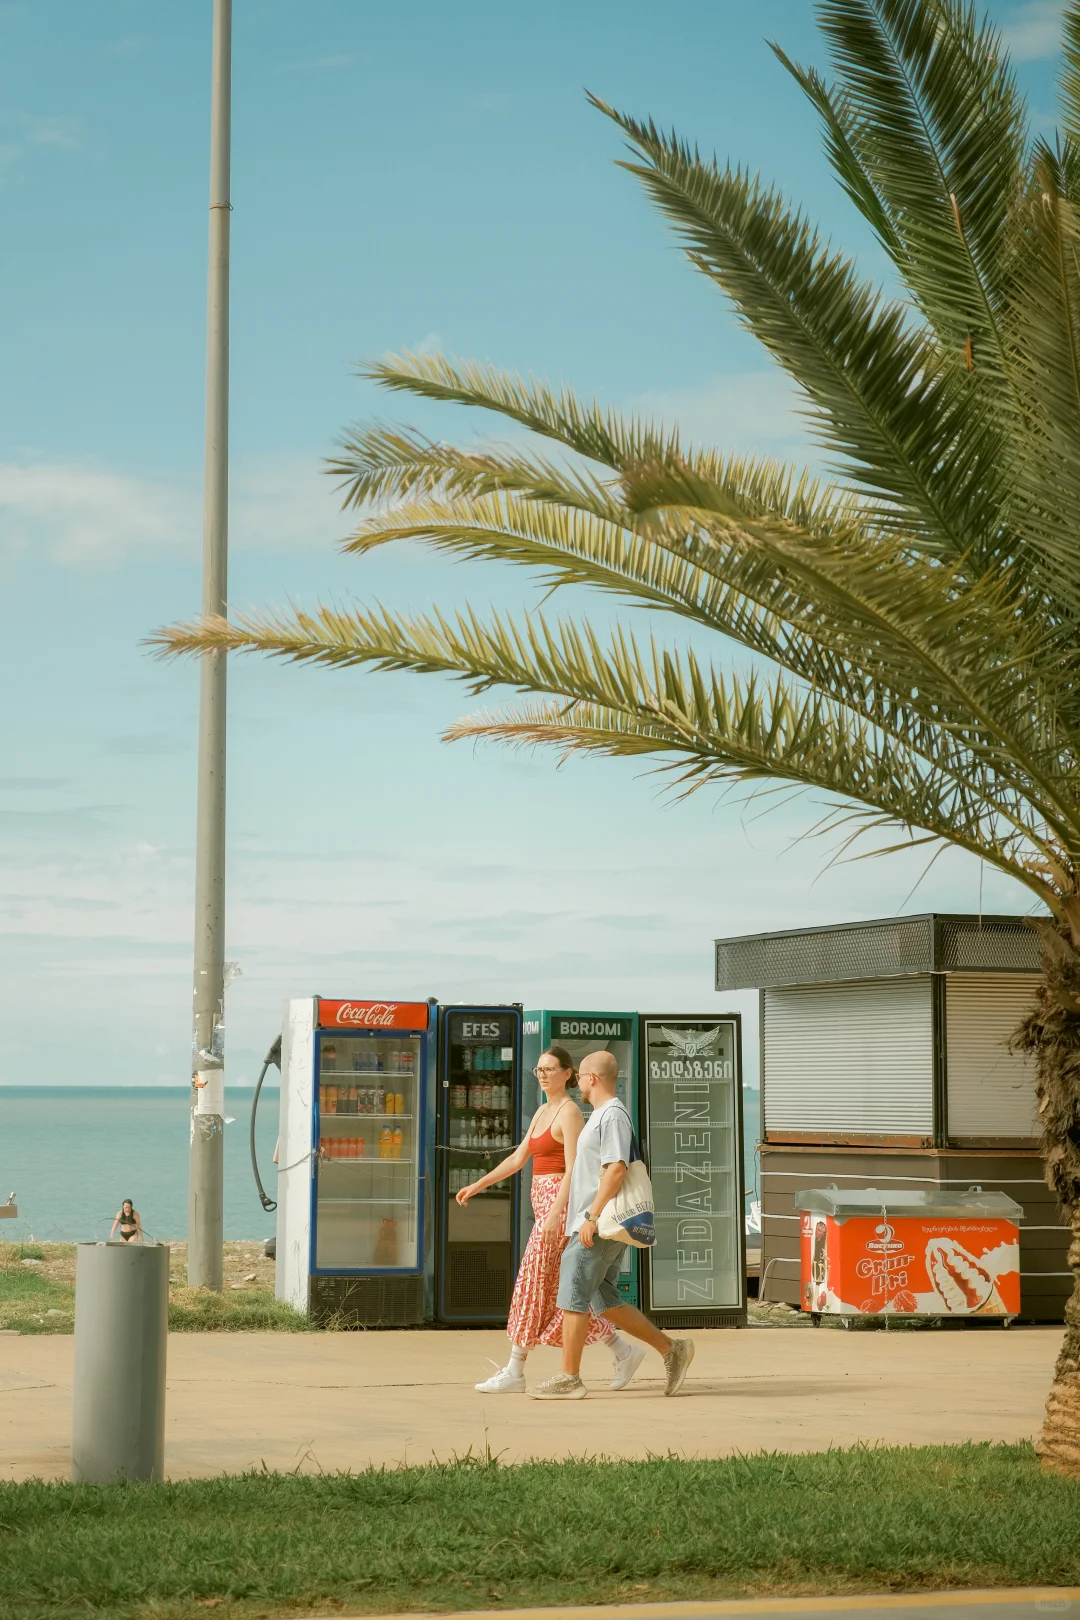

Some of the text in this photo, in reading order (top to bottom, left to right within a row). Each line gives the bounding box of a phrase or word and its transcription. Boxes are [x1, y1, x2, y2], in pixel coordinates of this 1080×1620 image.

[336, 1002, 398, 1025] Coca-Cola
[462, 1022, 500, 1037] EFES
[560, 1021, 621, 1036] BORJOMI
[650, 1060, 733, 1079] ზედაზენი
[673, 1083, 714, 1300] ZEDAZENI
[610, 1212, 627, 1224] You
[871, 1270, 908, 1296] Pri
